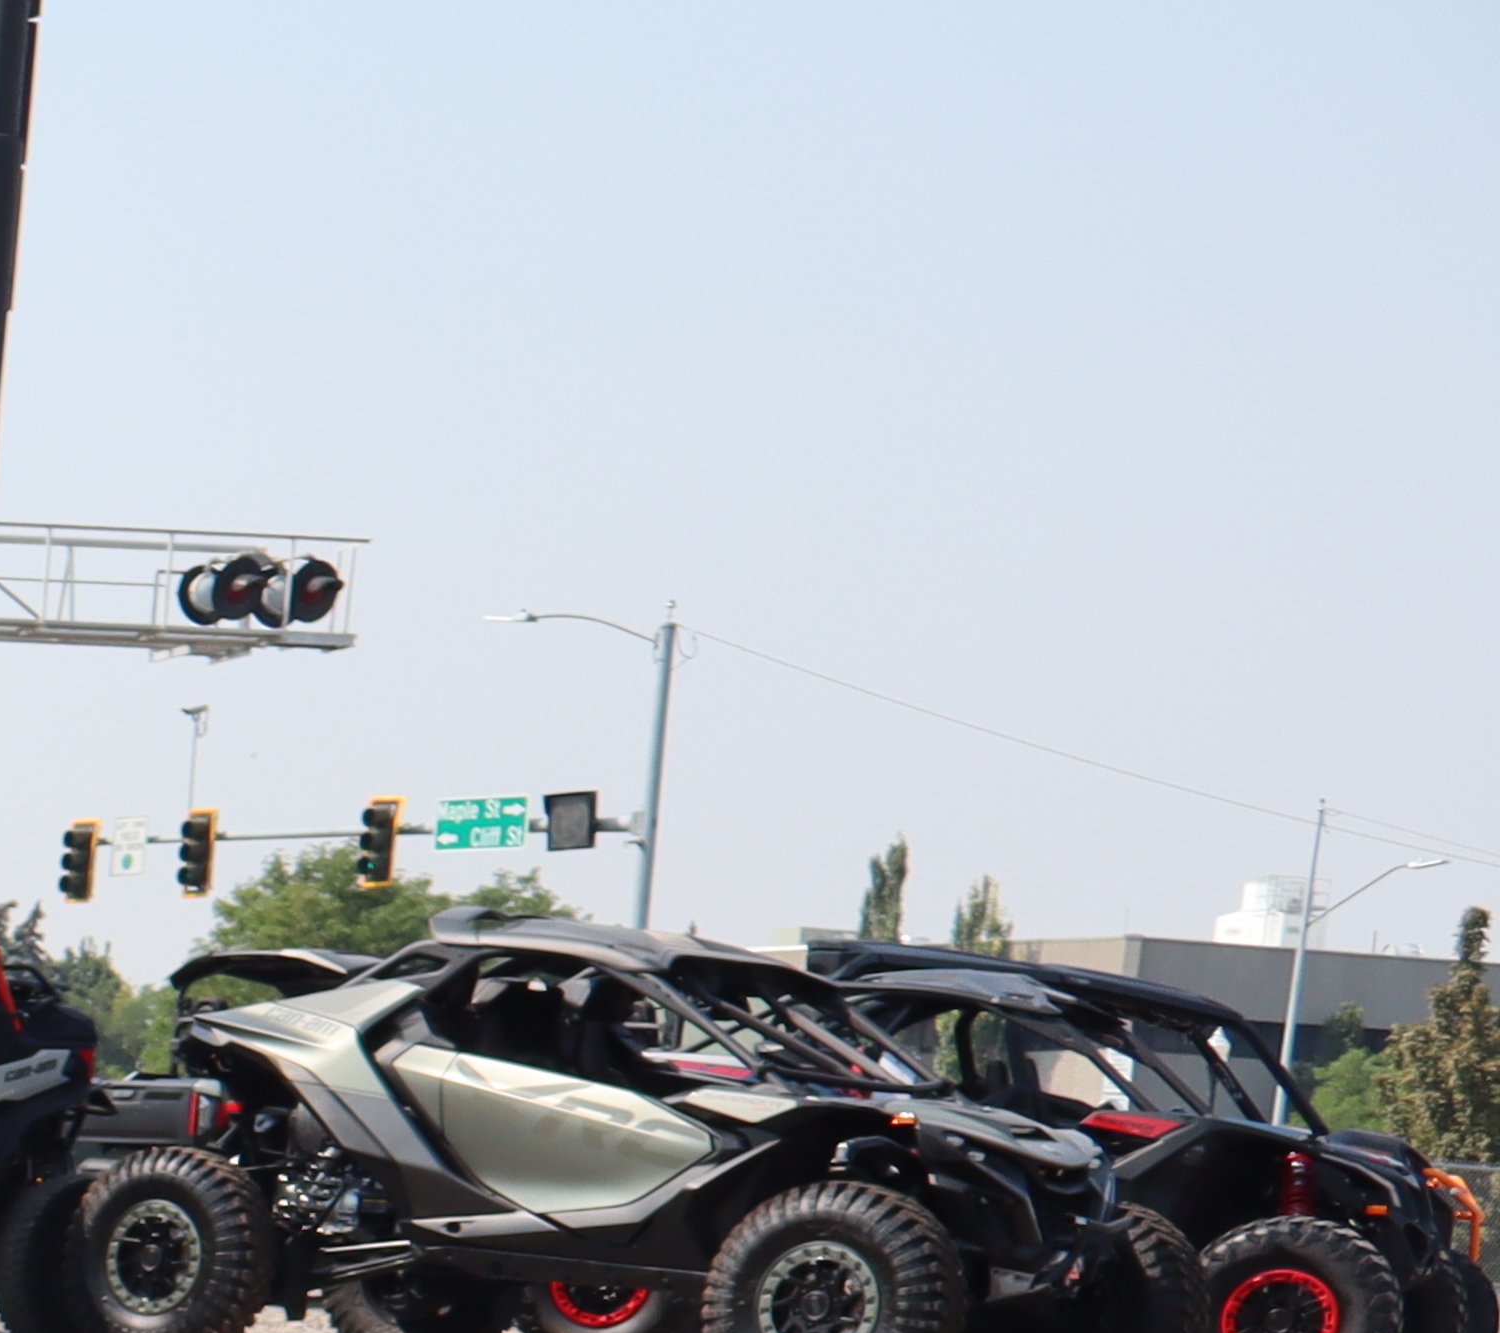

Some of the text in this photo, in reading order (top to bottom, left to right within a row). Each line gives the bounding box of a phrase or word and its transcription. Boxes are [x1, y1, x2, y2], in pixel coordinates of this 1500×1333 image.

[438, 799, 501, 824] Maple St
[469, 825, 523, 848] Cliff St
